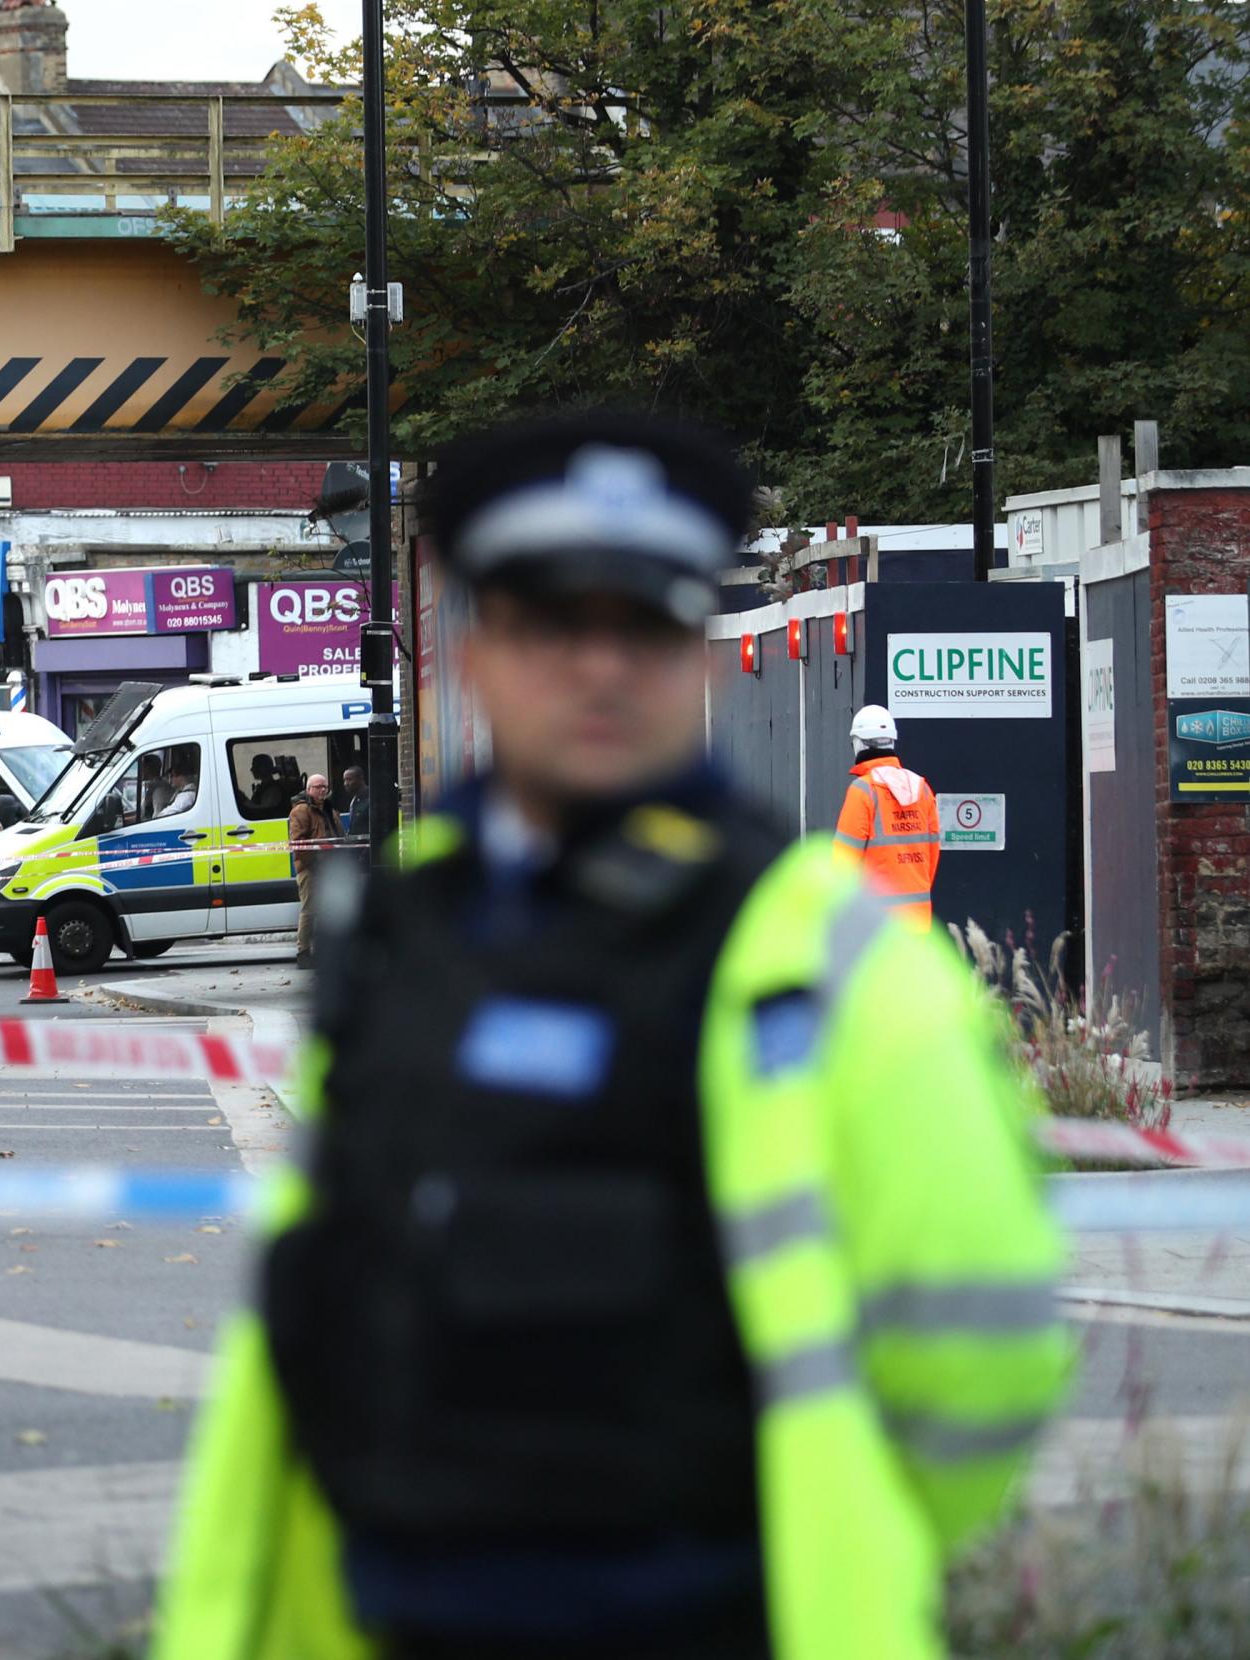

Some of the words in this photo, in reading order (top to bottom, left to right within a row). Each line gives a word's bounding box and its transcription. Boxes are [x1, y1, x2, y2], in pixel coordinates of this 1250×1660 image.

[1023, 515, 1041, 534] Carter
[171, 575, 215, 598] QBS
[45, 577, 108, 622] QBS
[191, 602, 197, 610] &
[198, 601, 228, 611] Company
[270, 587, 361, 624] QBS
[167, 617, 182, 628] 020
[893, 648, 1045, 681] CLIPFINE
[1181, 676, 1196, 684] Call
[1198, 676, 1218, 684] 0208
[895, 690, 964, 698] CONSTRUCTION
[966, 689, 1004, 698] SUPPORT
[1007, 689, 1046, 697] SERVICES
[1187, 760, 1203, 770] 020
[1205, 760, 1227, 770] 8365
[892, 810, 919, 820] TRAFFIC
[965, 807, 973, 820] 5
[951, 832, 973, 843] Speed
[974, 832, 991, 842] limit
